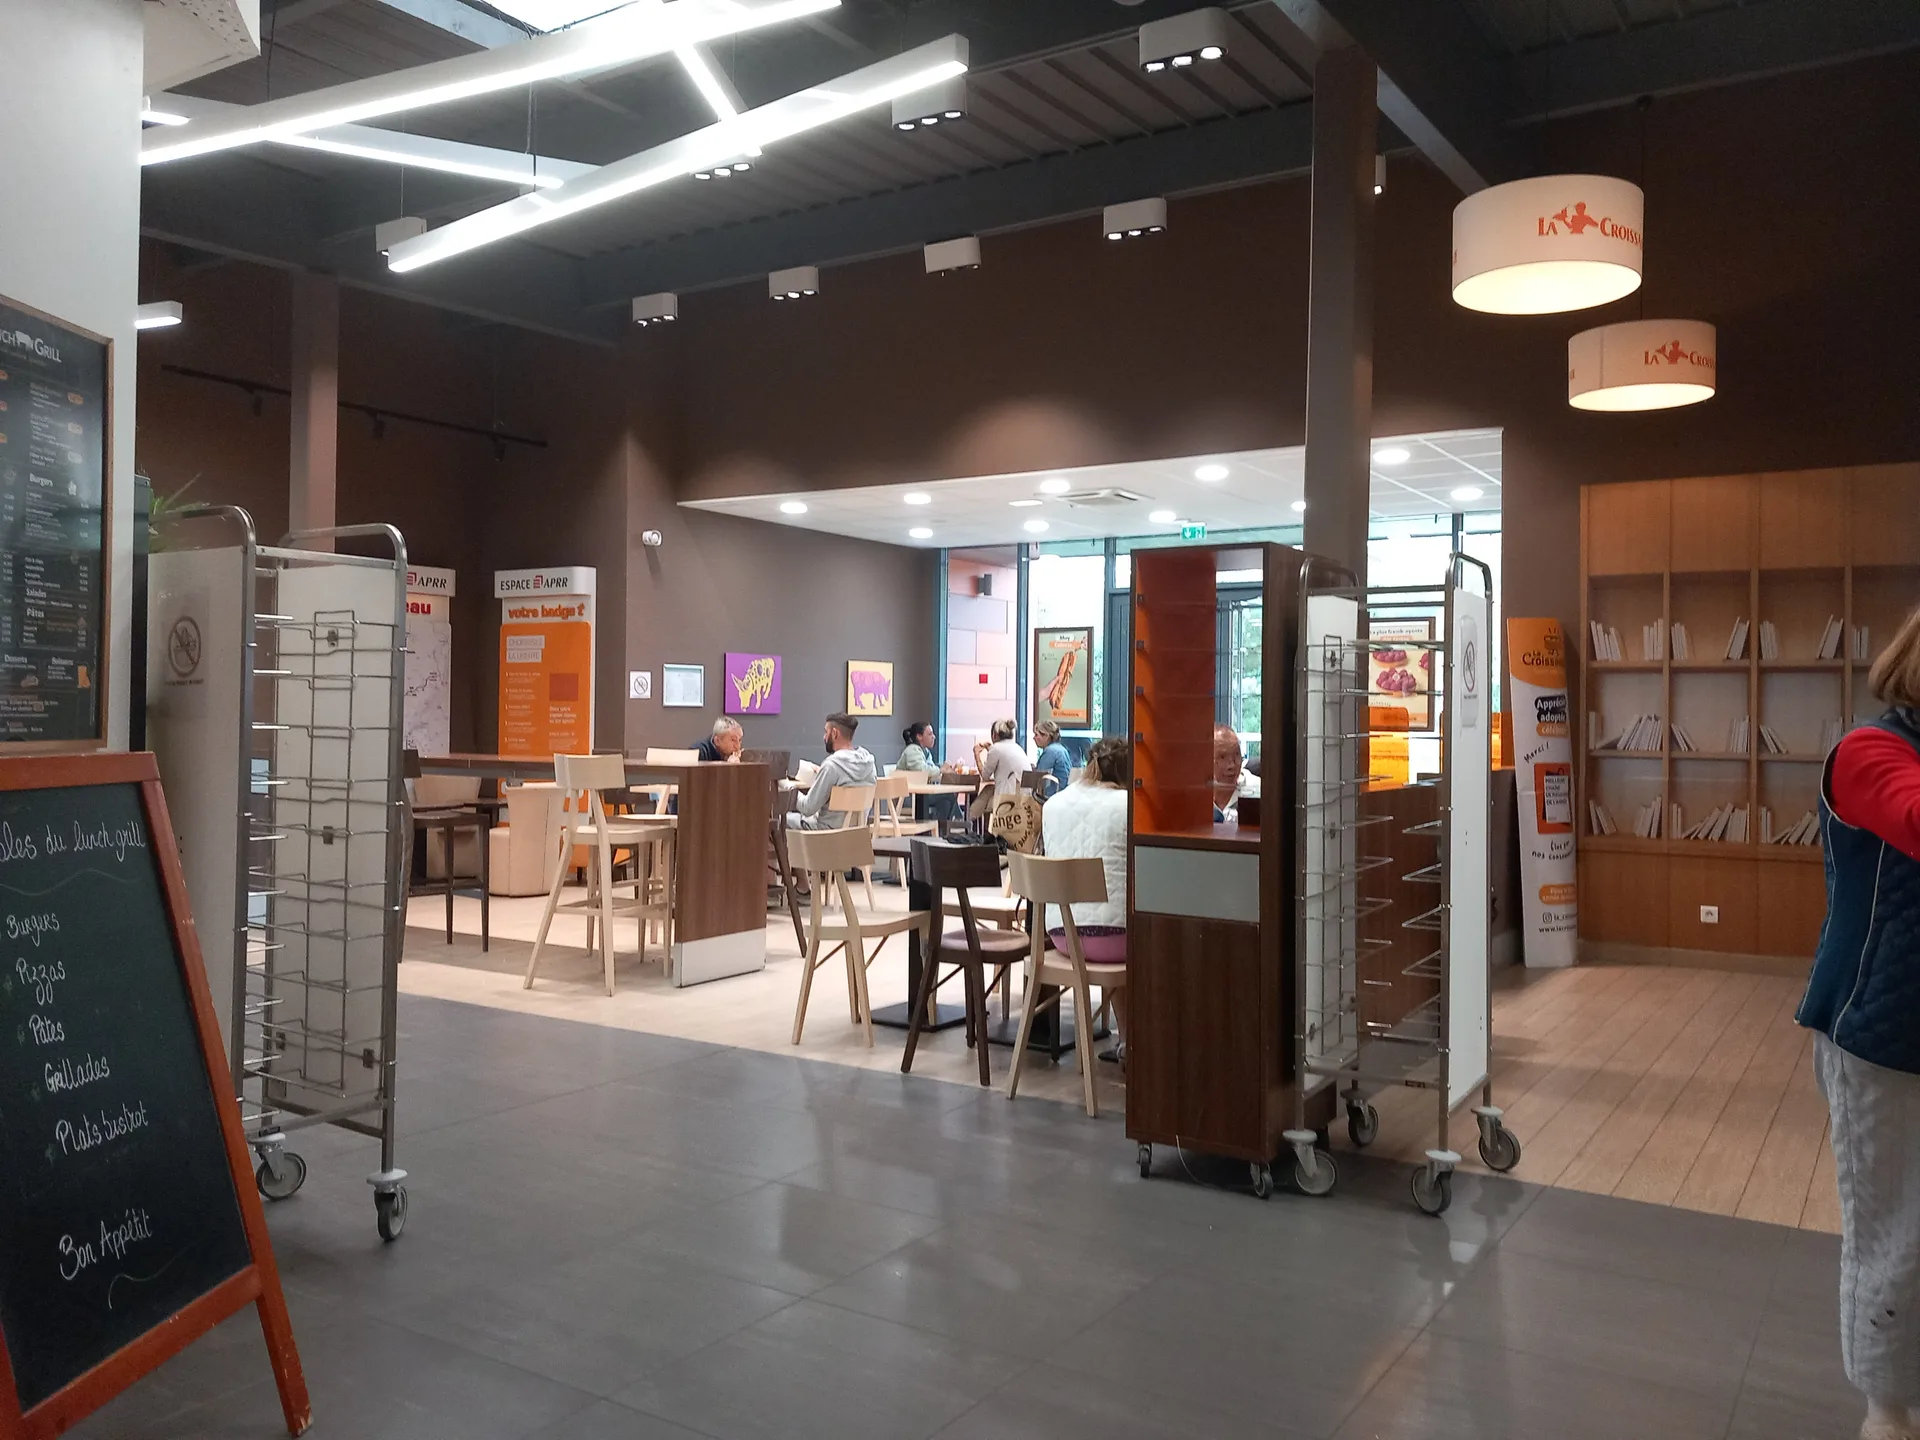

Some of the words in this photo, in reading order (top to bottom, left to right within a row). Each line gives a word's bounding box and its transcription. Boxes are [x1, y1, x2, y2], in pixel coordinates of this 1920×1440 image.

[1538, 216, 1557, 236] LA
[0, 330, 16, 346] CH
[34, 337, 62, 363] GRILL
[417, 576, 447, 589] APRR
[500, 579, 530, 591] ESPACE
[543, 576, 568, 589] APRR
[508, 605, 539, 618] votre
[541, 604, 576, 620] badge
[1523, 745, 1545, 764] Merci
[992, 814, 1022, 830] ange
[46, 824, 67, 855] du
[73, 820, 115, 852] lunch
[115, 820, 146, 862] grill
[6, 912, 60, 947] Burgers
[15, 957, 66, 1006] Pizzas
[44, 1053, 110, 1093] Grillades
[56, 1114, 102, 1155] Plats
[101, 1100, 149, 1141] bistrot
[59, 1234, 97, 1280] Bon
[100, 1208, 153, 1260] Appétit
